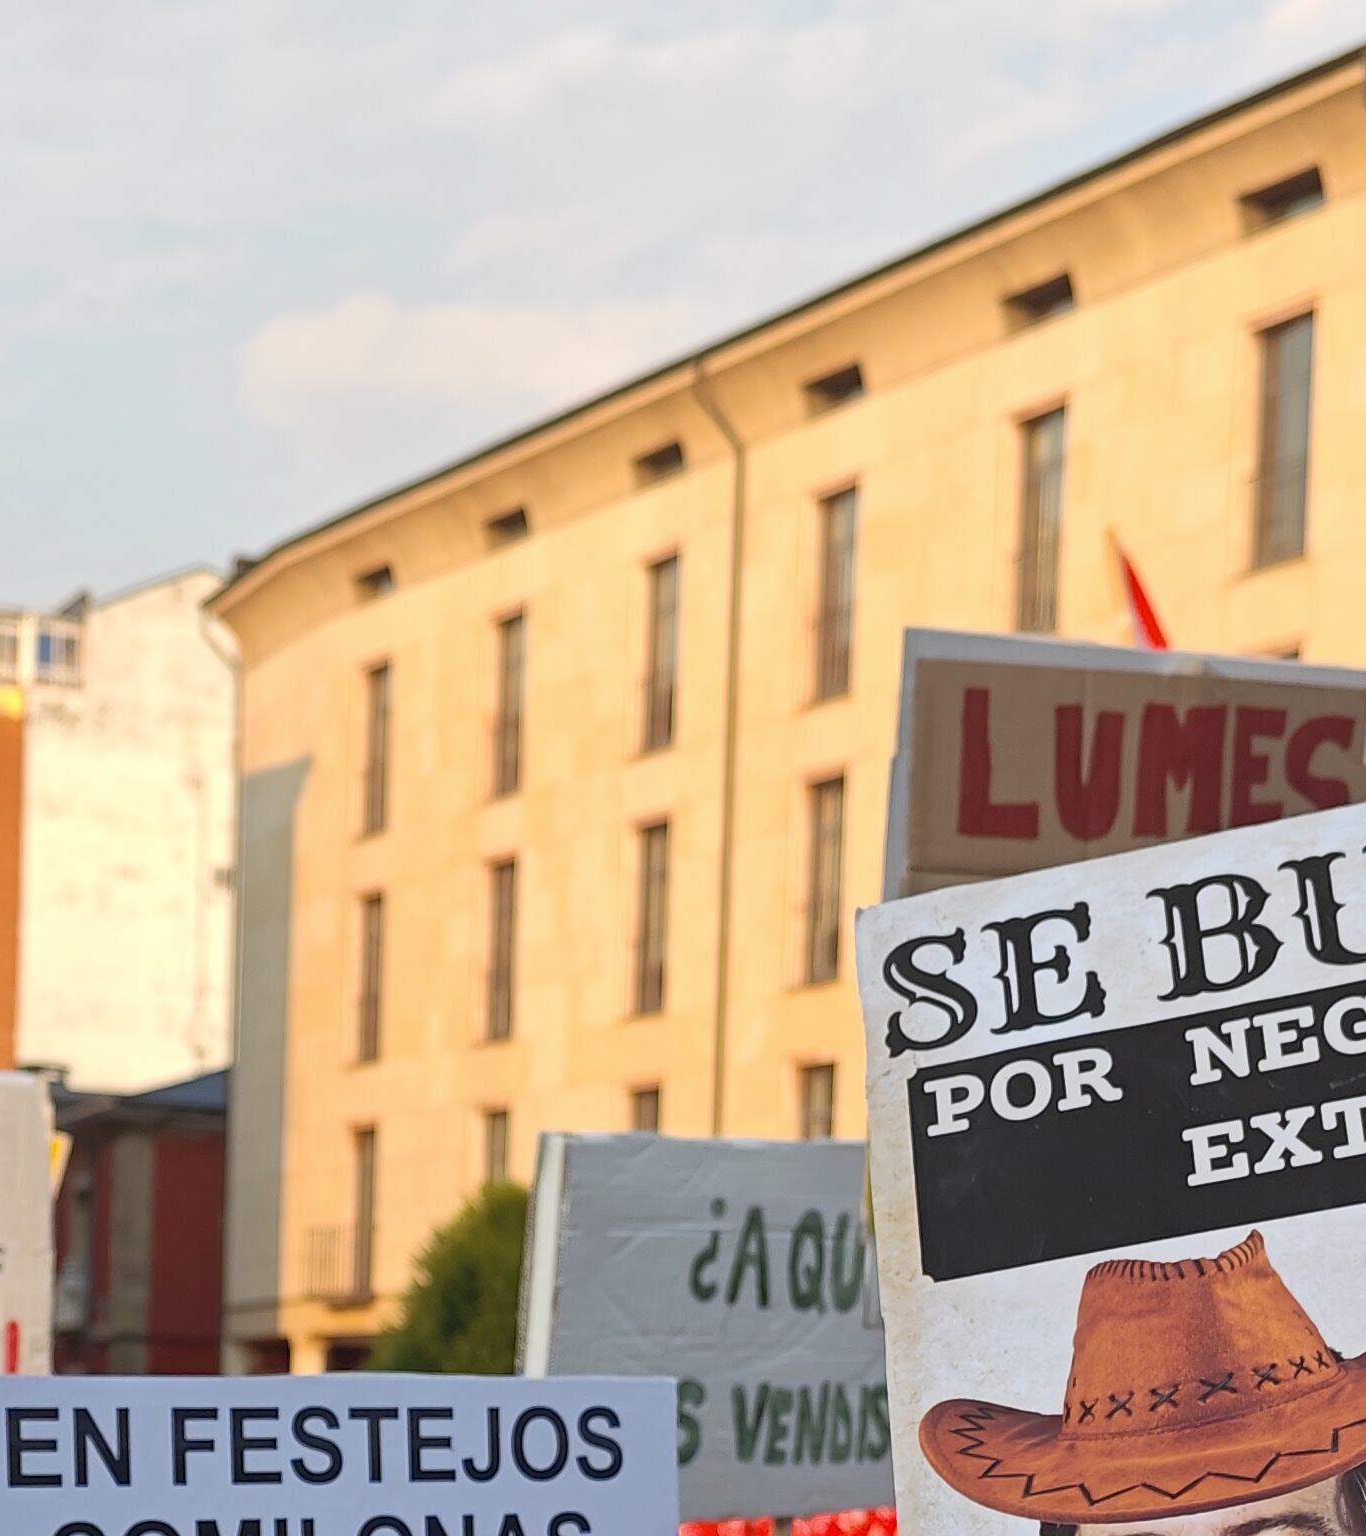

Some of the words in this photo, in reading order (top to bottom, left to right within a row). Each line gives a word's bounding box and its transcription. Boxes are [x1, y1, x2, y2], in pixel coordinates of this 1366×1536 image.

[959, 687, 1356, 840] LUMES
[881, 900, 1107, 1060] SE
[922, 1044, 1125, 1140] POR
[5, 1406, 131, 1489] EN
[171, 1405, 624, 1486] FESTEJOS
